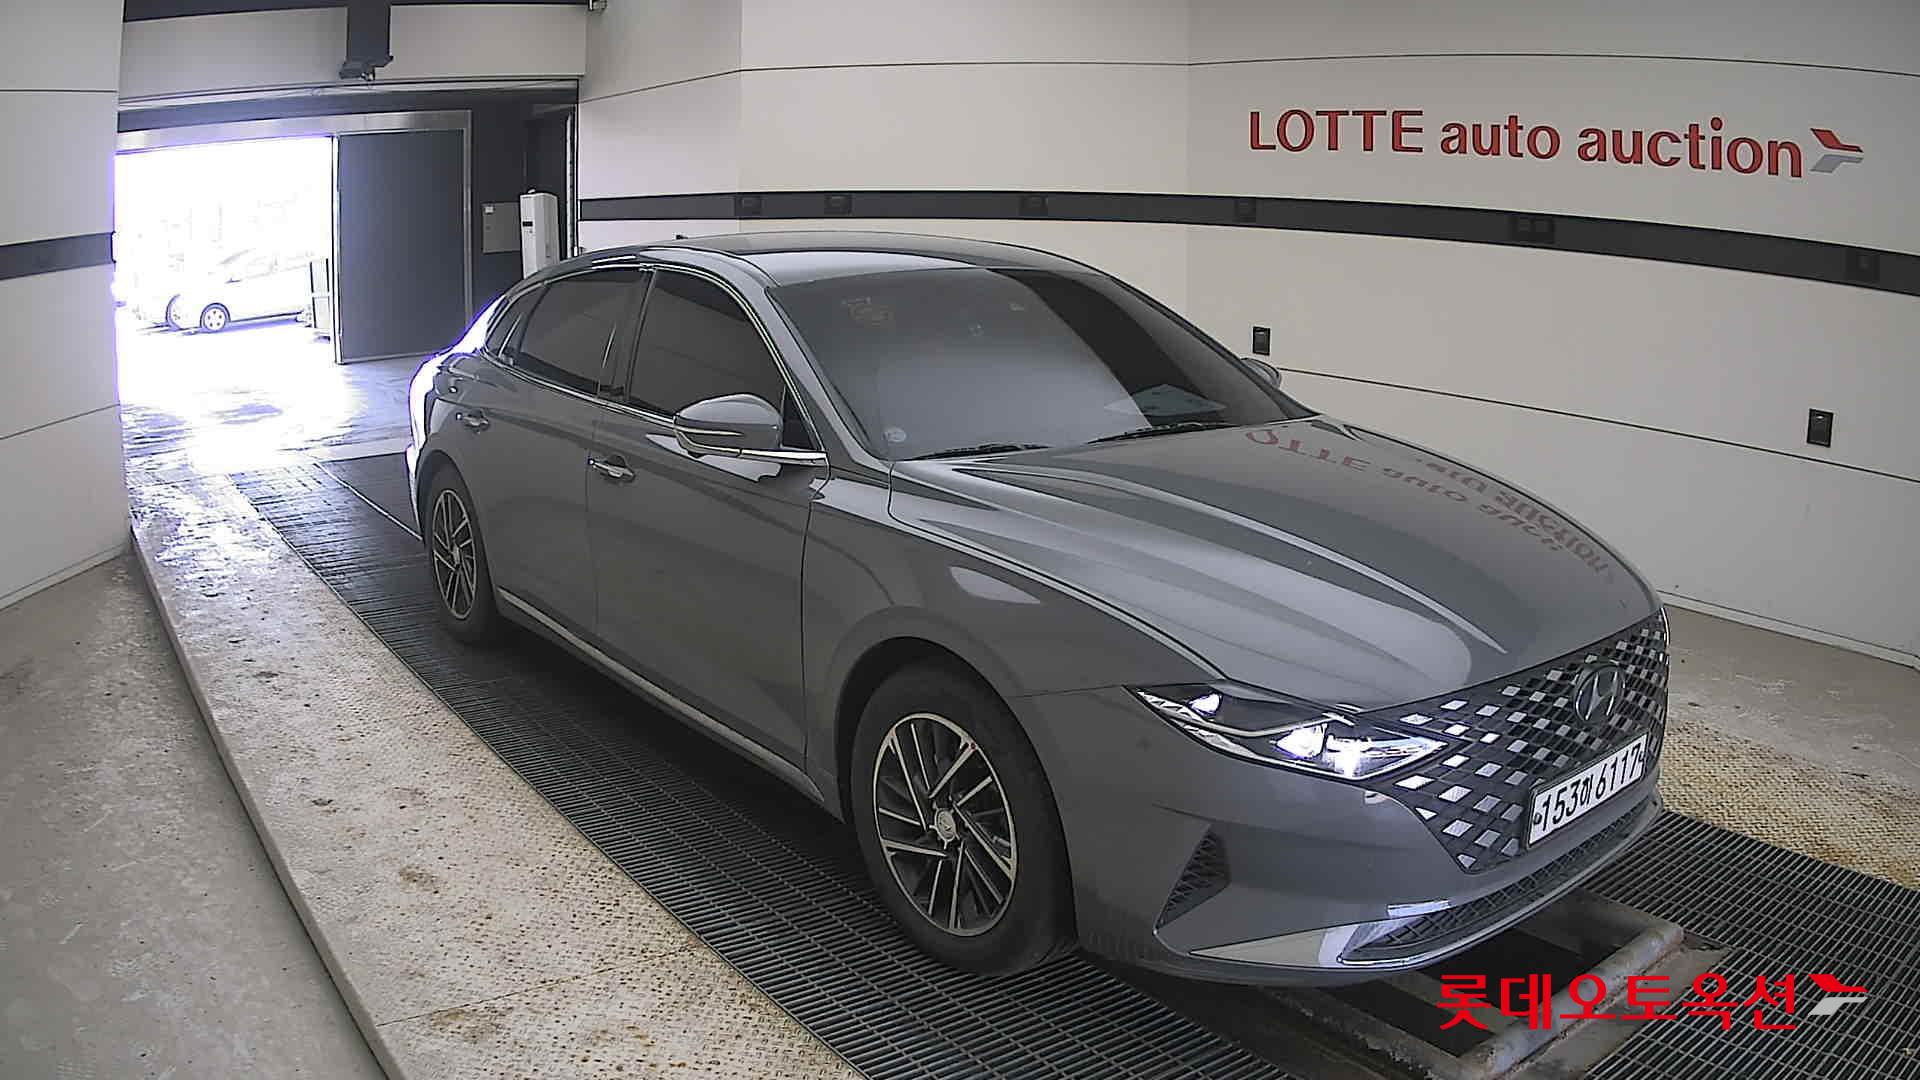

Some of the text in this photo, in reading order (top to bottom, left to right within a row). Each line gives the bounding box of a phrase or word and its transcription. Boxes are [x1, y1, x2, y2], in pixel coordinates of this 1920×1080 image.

[1249, 109, 1803, 178] LOTTE auto auction
